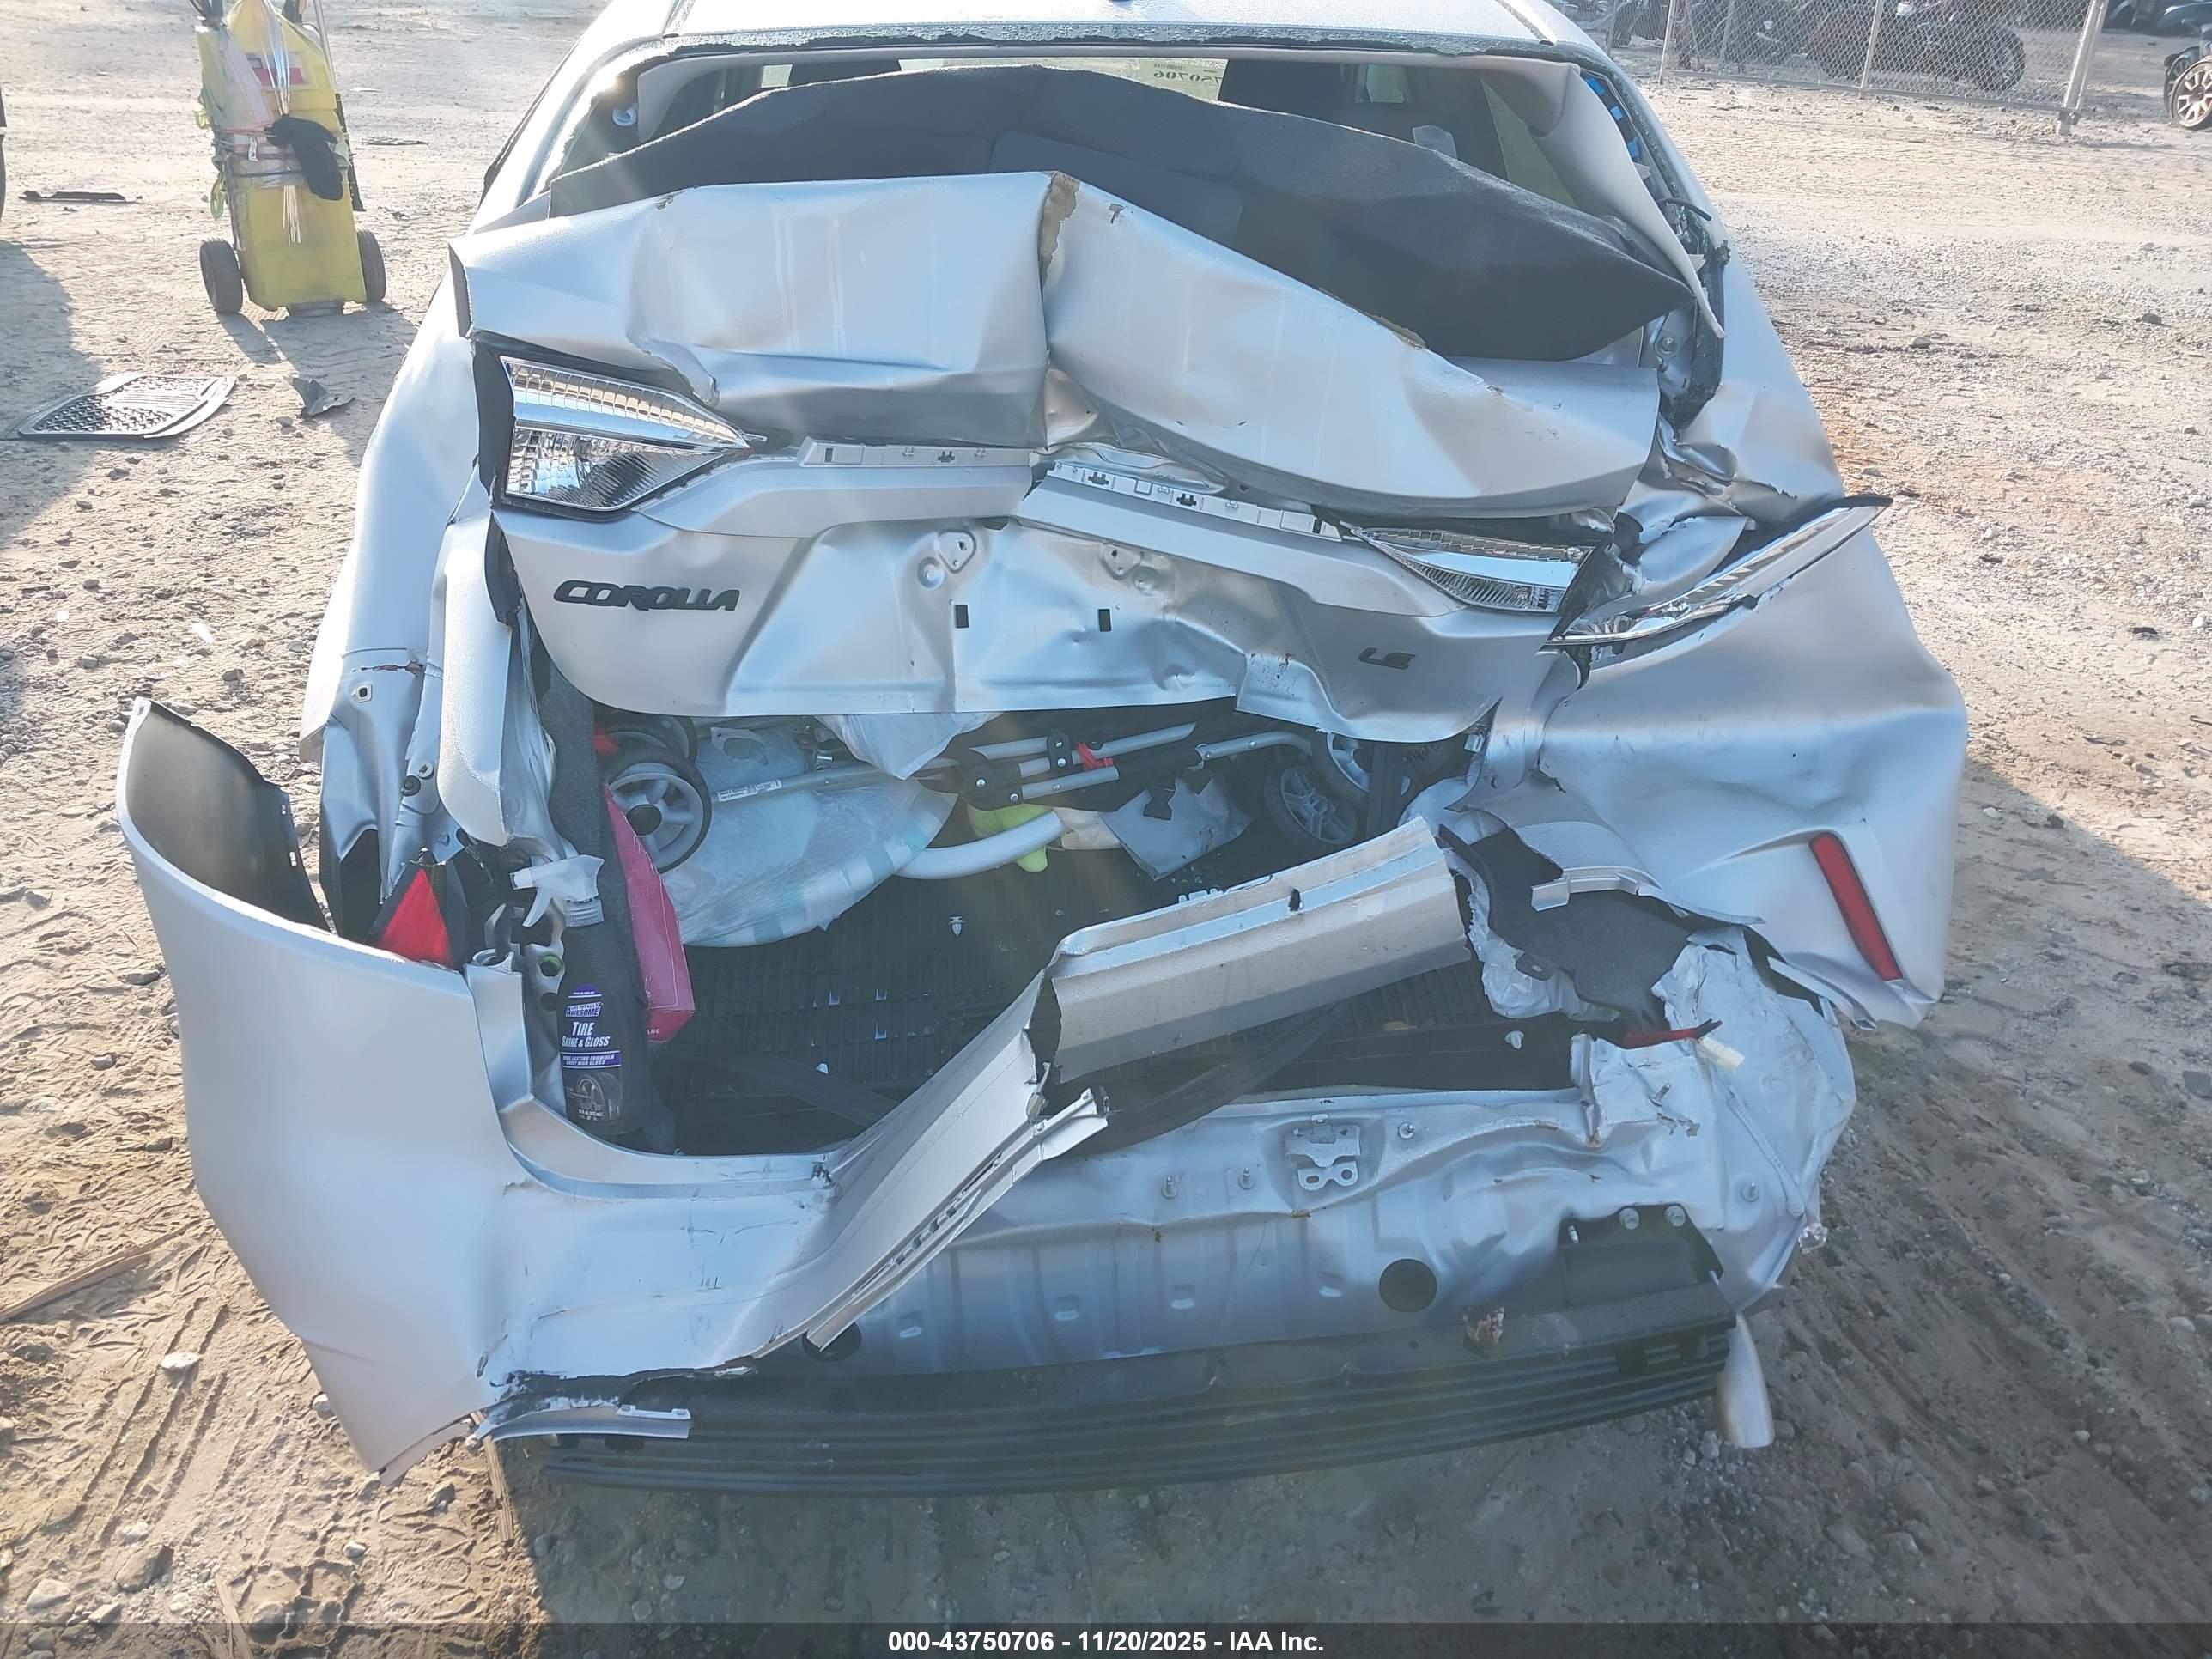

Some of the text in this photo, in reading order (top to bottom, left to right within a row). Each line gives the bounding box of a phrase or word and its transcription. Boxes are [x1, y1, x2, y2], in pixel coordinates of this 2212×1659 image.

[554, 580, 740, 611] COROLLA
[1358, 647, 1416, 670] LE
[567, 1006, 599, 1017] AWESOME
[572, 1022, 594, 1036] TIRE
[562, 1036, 579, 1048] SHINE
[585, 1036, 611, 1048] GLOSS
